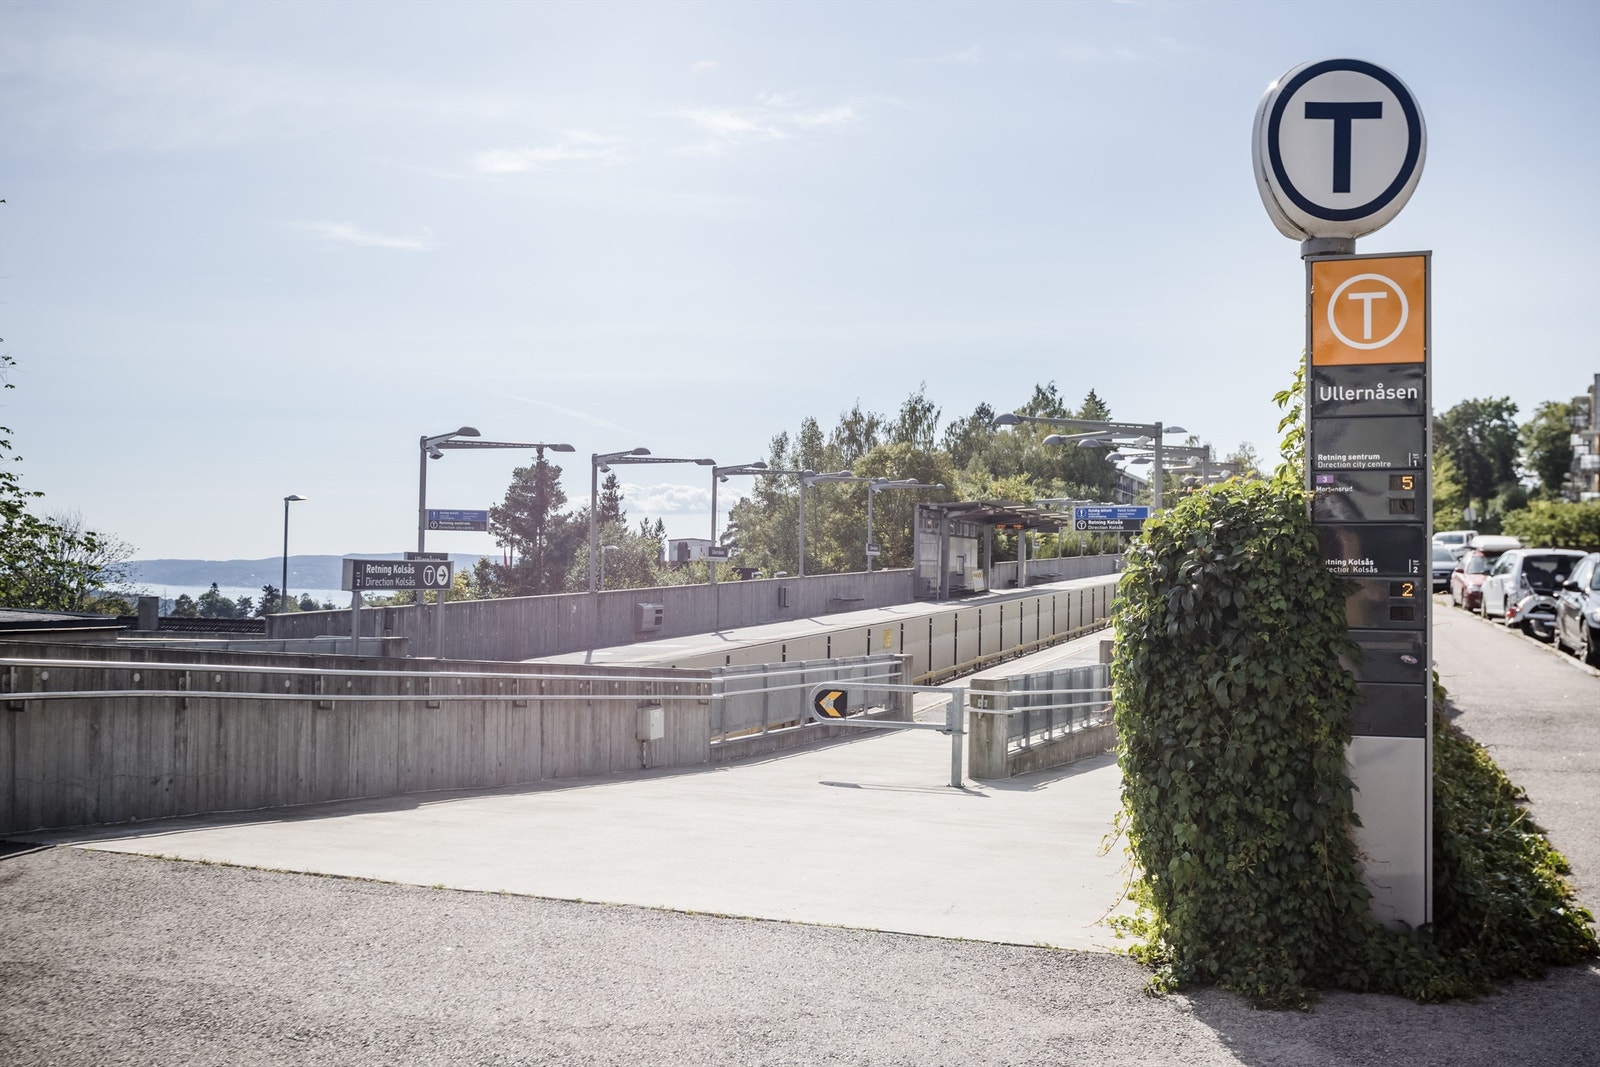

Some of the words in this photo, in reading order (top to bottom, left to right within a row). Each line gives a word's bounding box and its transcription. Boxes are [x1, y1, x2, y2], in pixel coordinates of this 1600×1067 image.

[1304, 101, 1383, 193] T
[1348, 291, 1387, 339] T
[1320, 383, 1418, 401] Ullernåsen
[1352, 461, 1366, 469] city
[1402, 476, 1413, 490] 5
[1325, 558, 1347, 566] tning
[1348, 557, 1374, 566] Kolsås
[366, 564, 391, 575] Retning
[393, 563, 415, 574] Kolsås
[1353, 565, 1378, 573] Kolsås
[365, 576, 394, 586] Direction
[395, 576, 416, 586] Kolsås
[1402, 582, 1413, 597] 2
